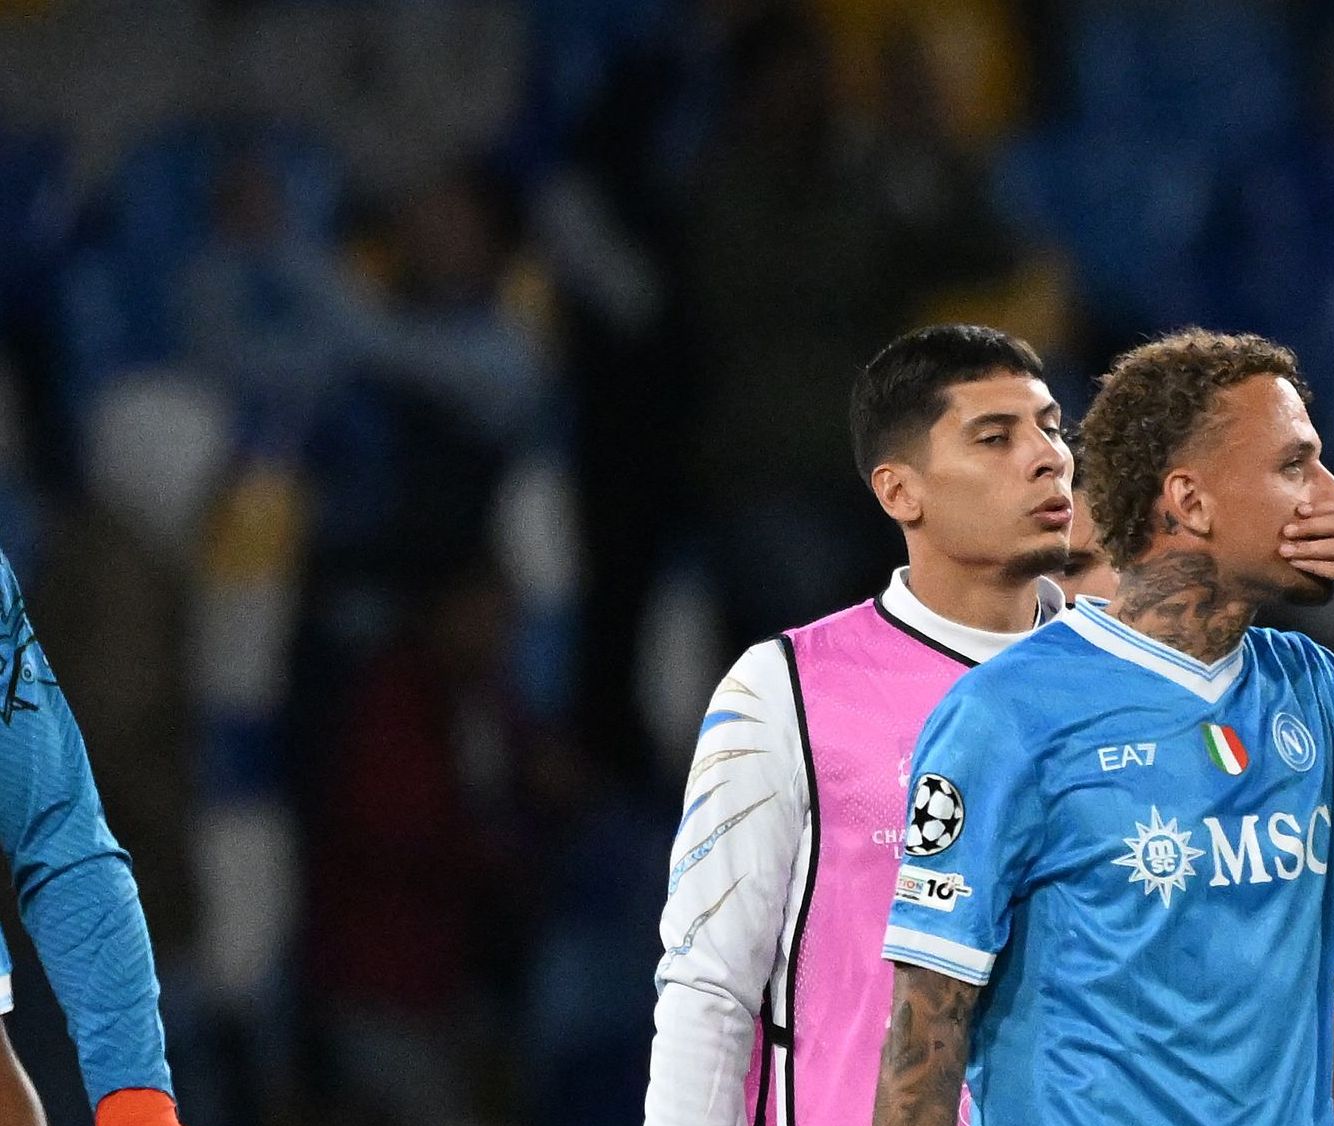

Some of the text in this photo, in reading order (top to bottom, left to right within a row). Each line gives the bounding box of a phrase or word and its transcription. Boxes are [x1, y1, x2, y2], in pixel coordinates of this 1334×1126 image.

[1097, 742, 1157, 772] EA7
[1281, 729, 1304, 757] N
[1203, 804, 1332, 887] MSC
